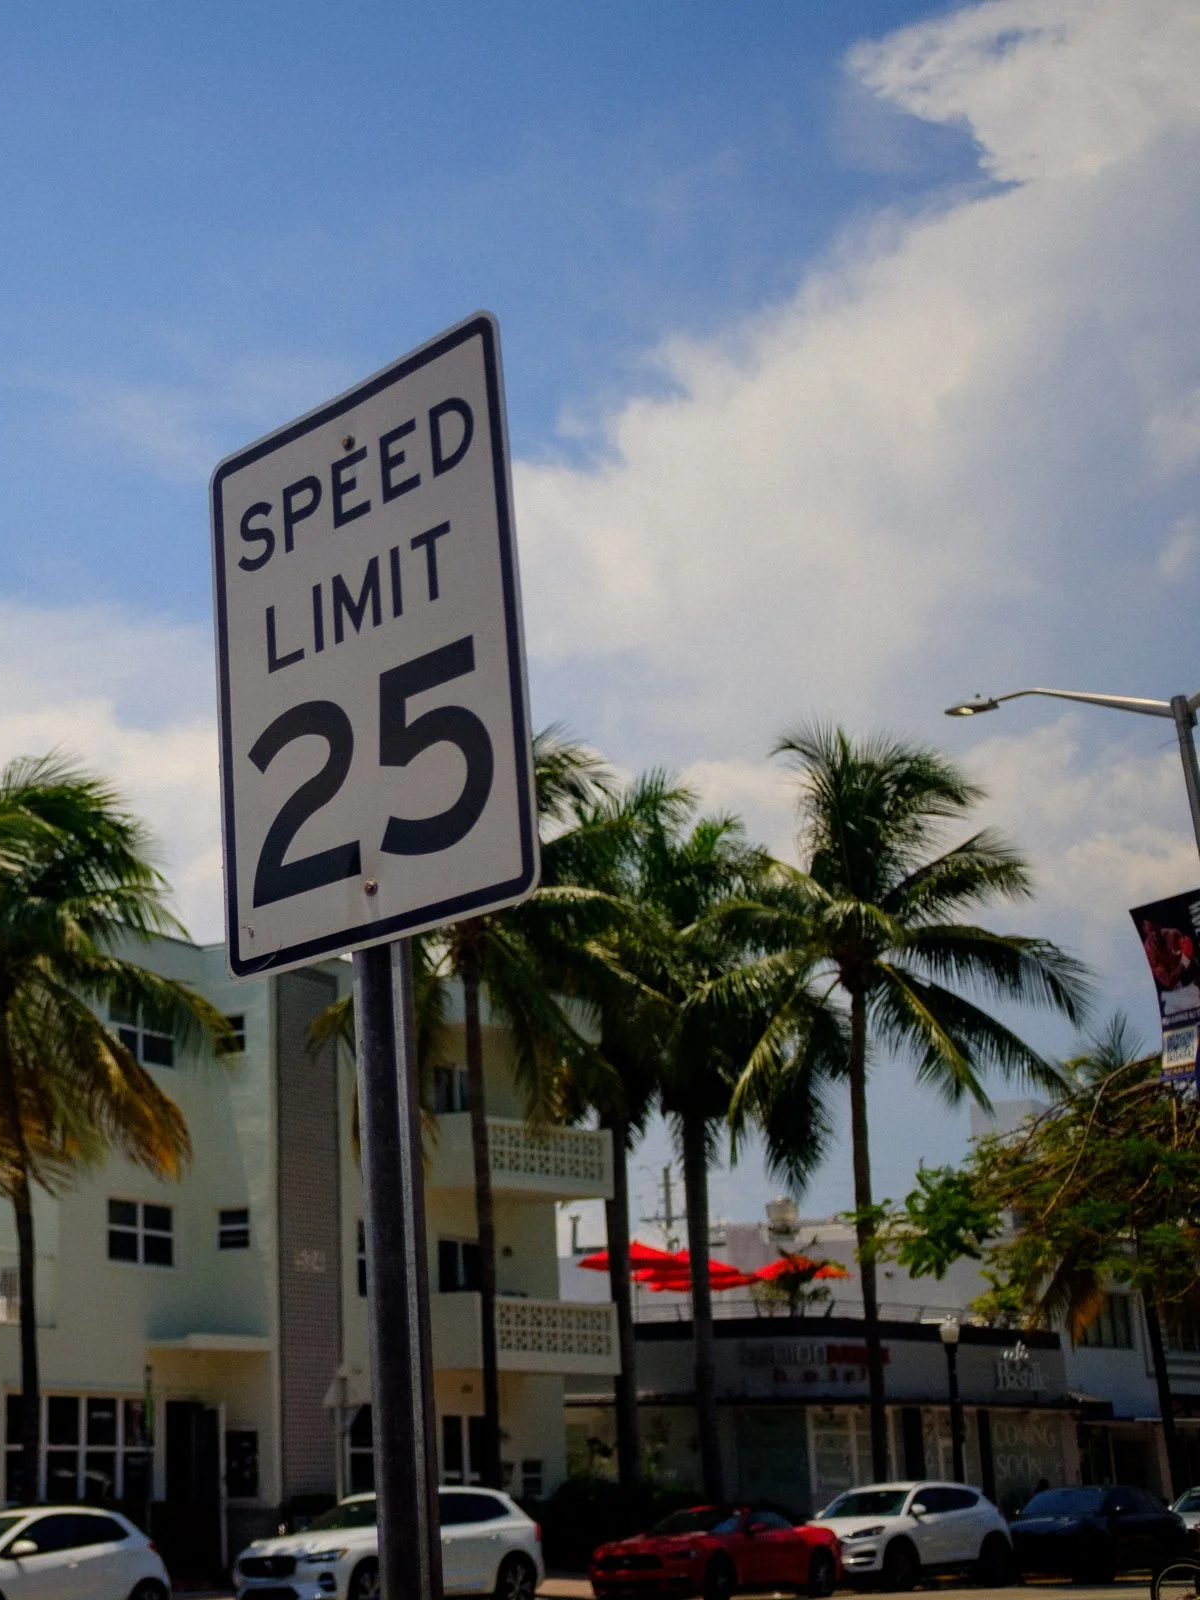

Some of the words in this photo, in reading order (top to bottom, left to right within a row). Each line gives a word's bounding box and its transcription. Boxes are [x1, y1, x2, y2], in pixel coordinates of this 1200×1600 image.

[238, 397, 474, 571] SPEED
[266, 522, 450, 673] LIMIT
[248, 635, 494, 907] 25
